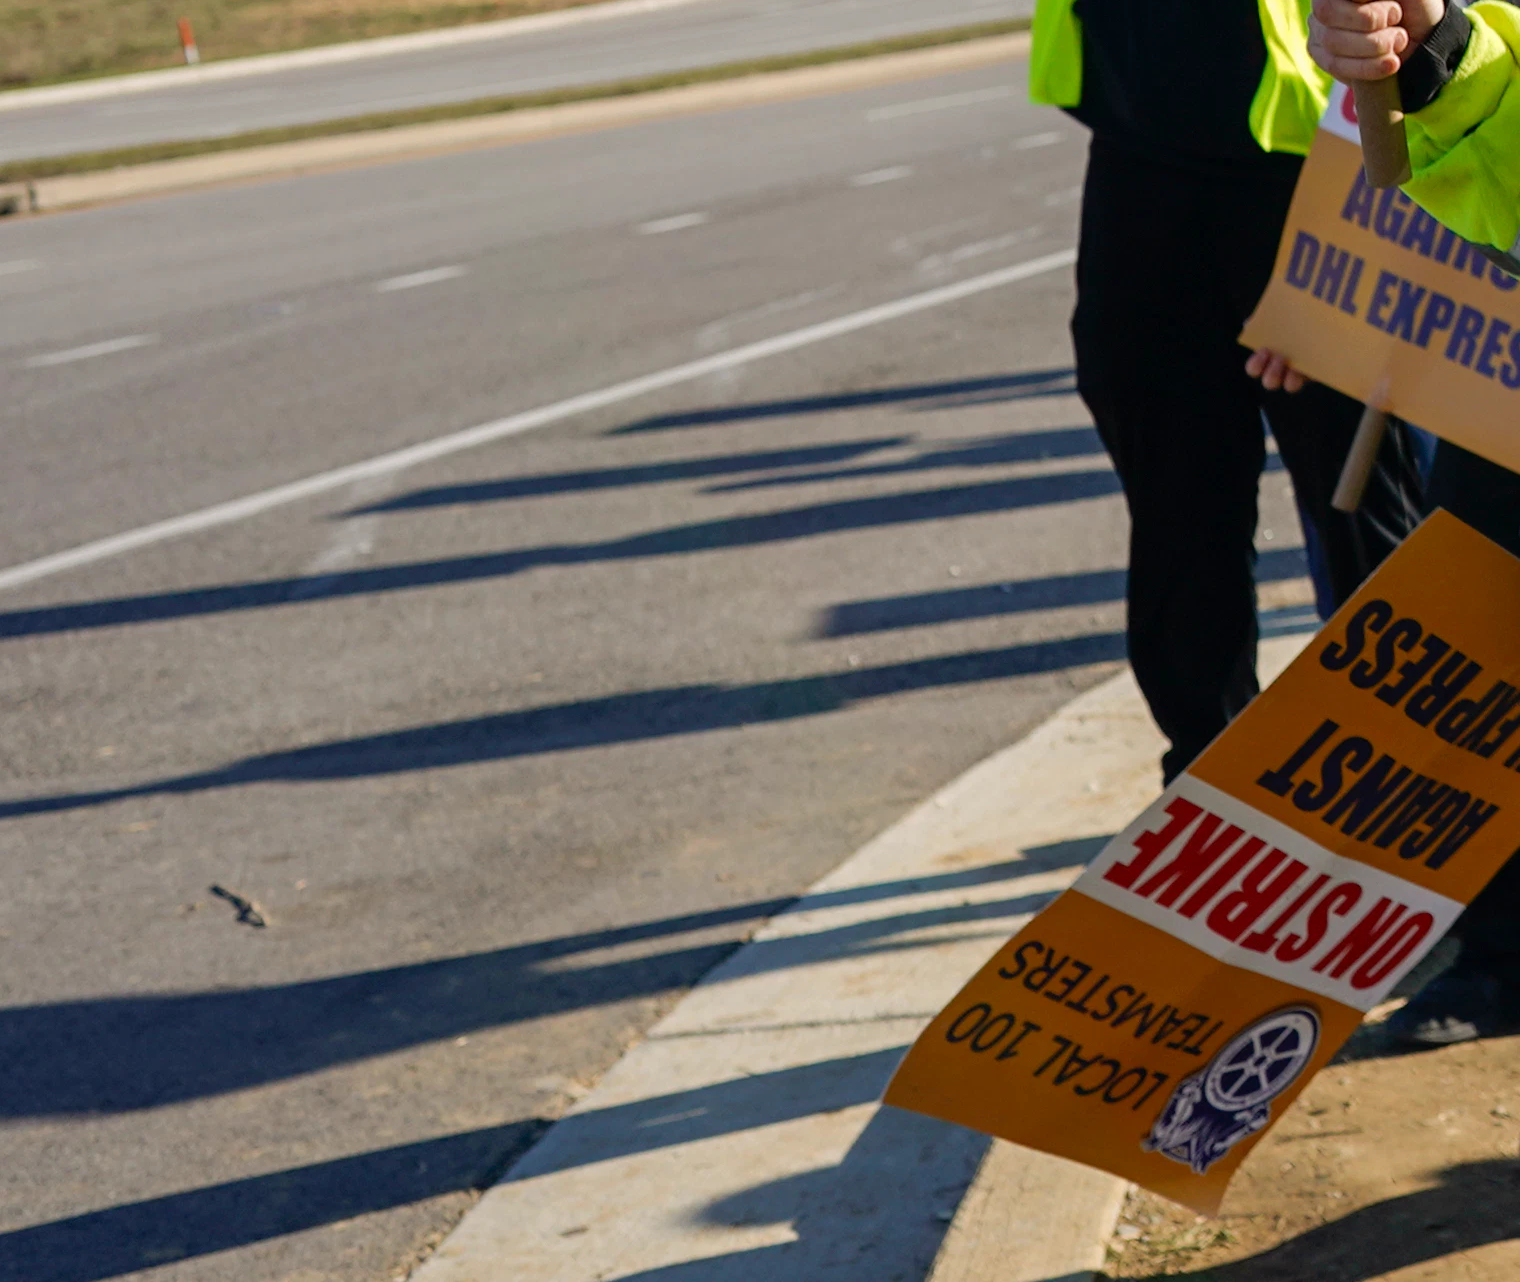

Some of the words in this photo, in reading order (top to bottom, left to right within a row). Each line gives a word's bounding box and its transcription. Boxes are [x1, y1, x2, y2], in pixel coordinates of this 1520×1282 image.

[1284, 229, 1365, 318] DHL
[1256, 718, 1500, 871] AGAINST
[1102, 795, 1363, 963] STRIKE
[1311, 896, 1434, 991] ON
[945, 1002, 1042, 1062] 100
[999, 940, 1224, 1055] TEAMSTERS
[1033, 1034, 1169, 1111] LOCAL
